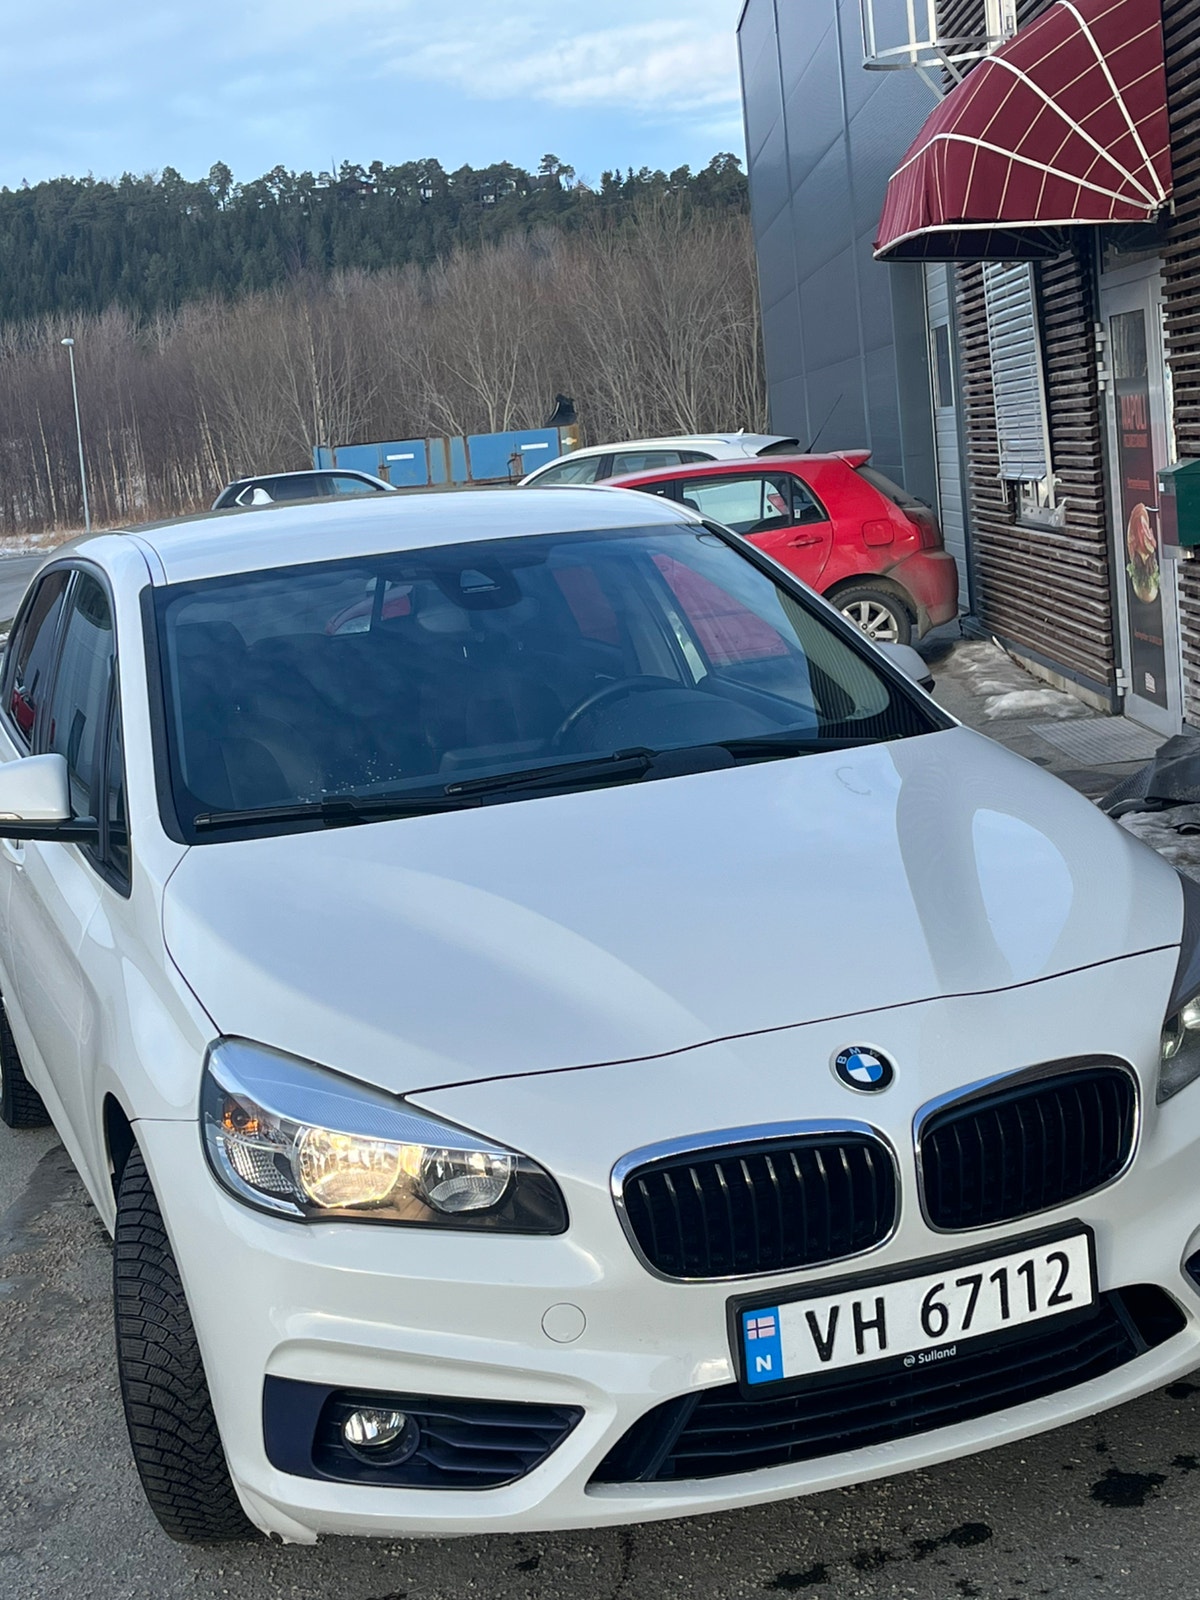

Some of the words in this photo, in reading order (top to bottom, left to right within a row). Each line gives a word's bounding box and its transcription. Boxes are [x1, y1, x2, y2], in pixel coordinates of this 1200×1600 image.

[837, 1047, 880, 1065] BMW
[805, 1297, 886, 1362] VH
[920, 1251, 1073, 1338] 67112
[756, 1354, 772, 1373] N
[918, 1344, 957, 1364] Sulland
